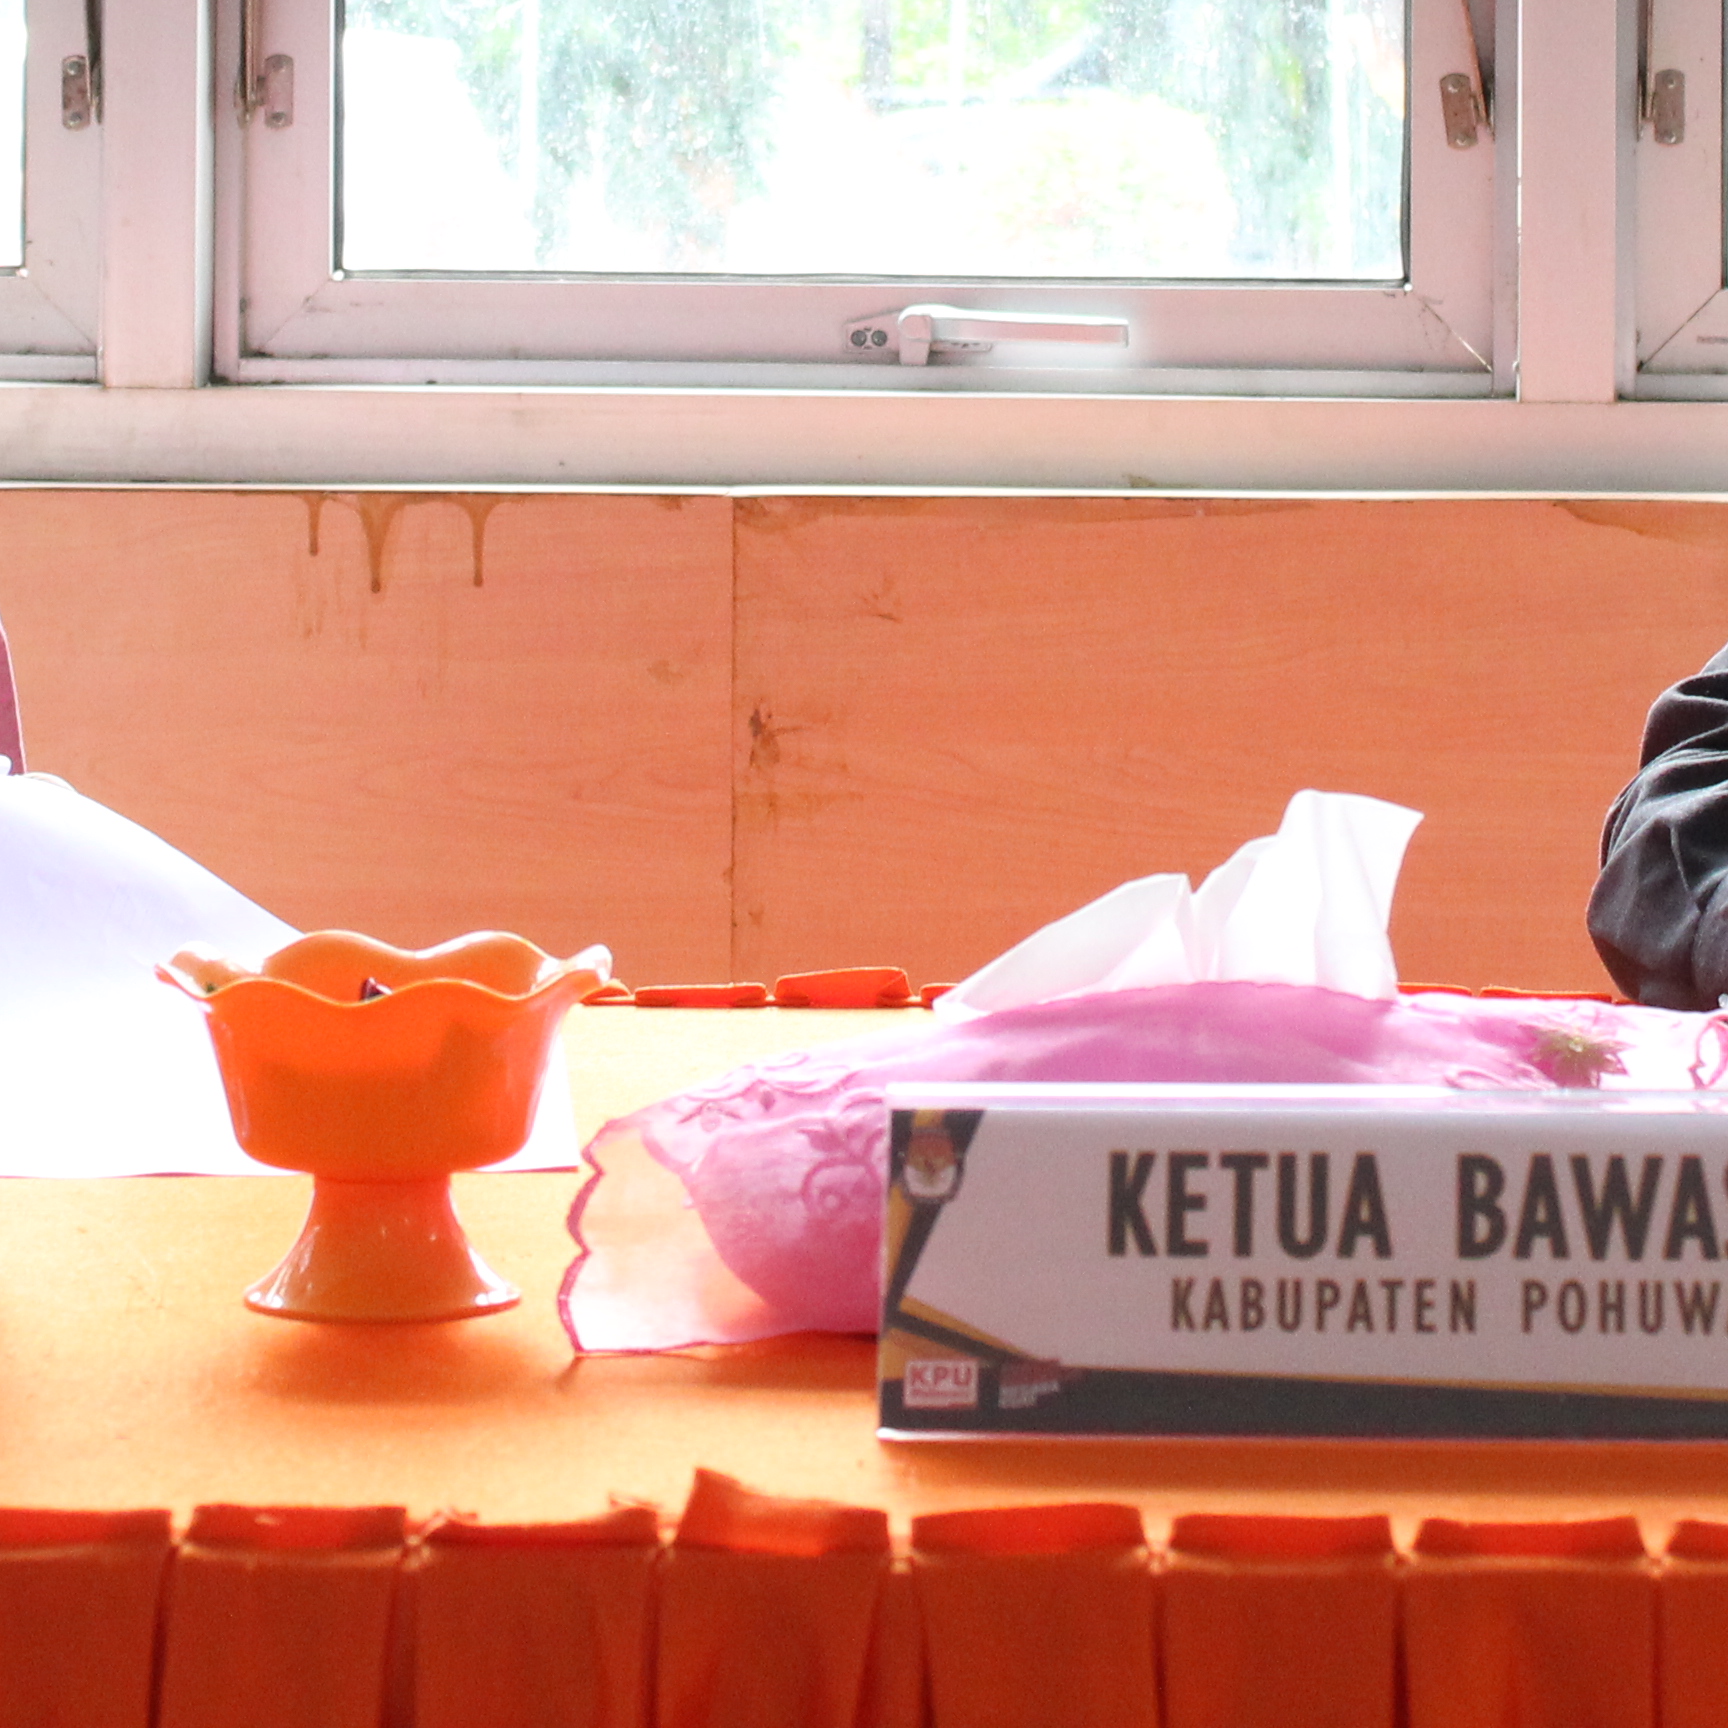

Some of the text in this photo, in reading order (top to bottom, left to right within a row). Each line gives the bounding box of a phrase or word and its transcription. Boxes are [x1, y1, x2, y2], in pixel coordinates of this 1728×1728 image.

[1107, 1149, 1393, 1260] KETUA
[1171, 1276, 1478, 1334] KABUPATEN
[911, 1366, 971, 1387] KPU
